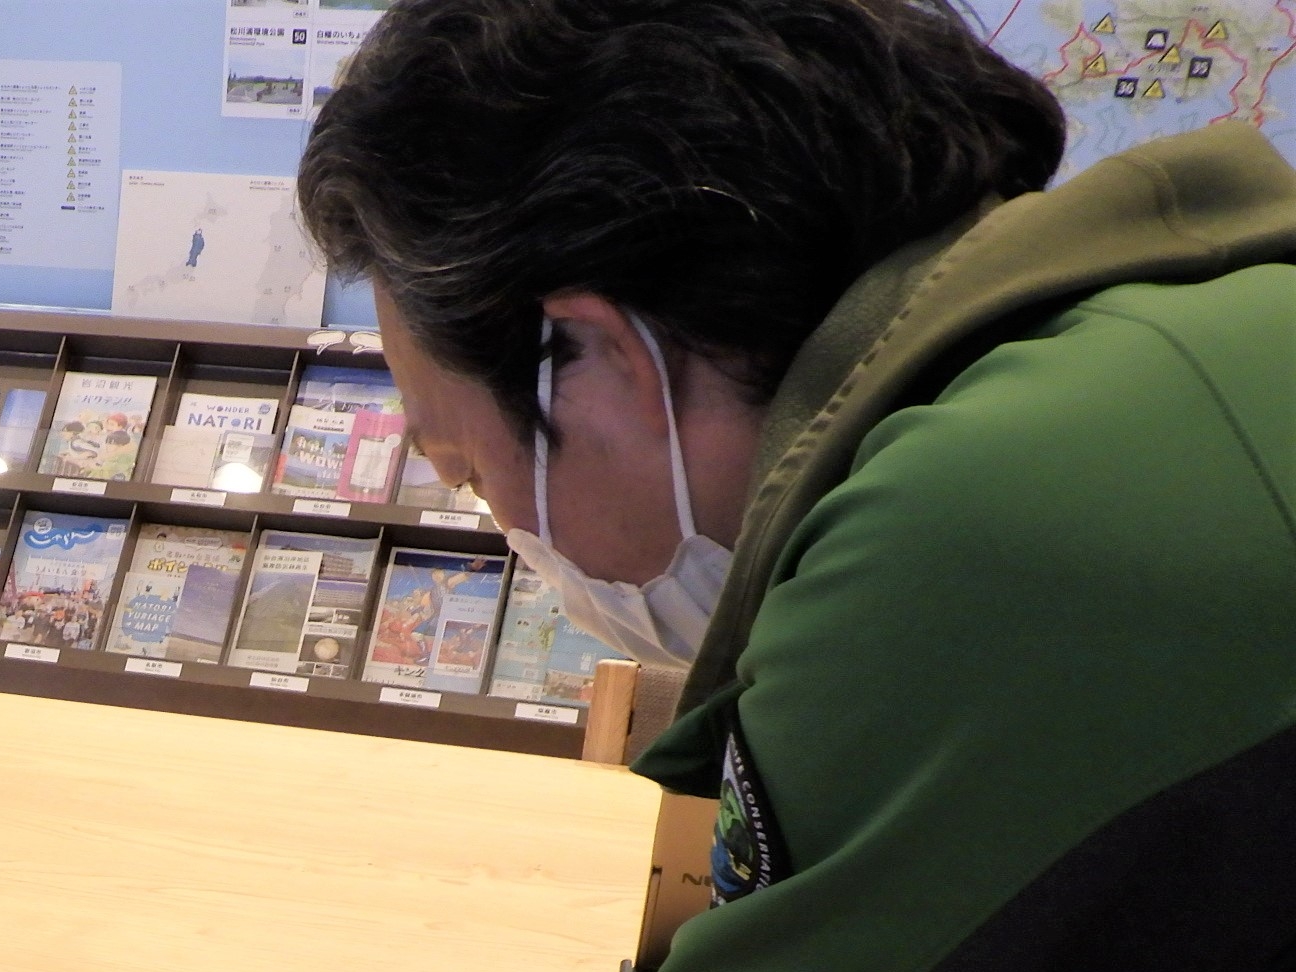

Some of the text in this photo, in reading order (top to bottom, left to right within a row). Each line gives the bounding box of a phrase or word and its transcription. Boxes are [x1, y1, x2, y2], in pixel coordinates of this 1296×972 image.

[188, 412, 262, 431] NATORI
[134, 601, 172, 611] NATORI
[128, 611, 172, 623] YURIAGE
[134, 622, 160, 632] MAP
